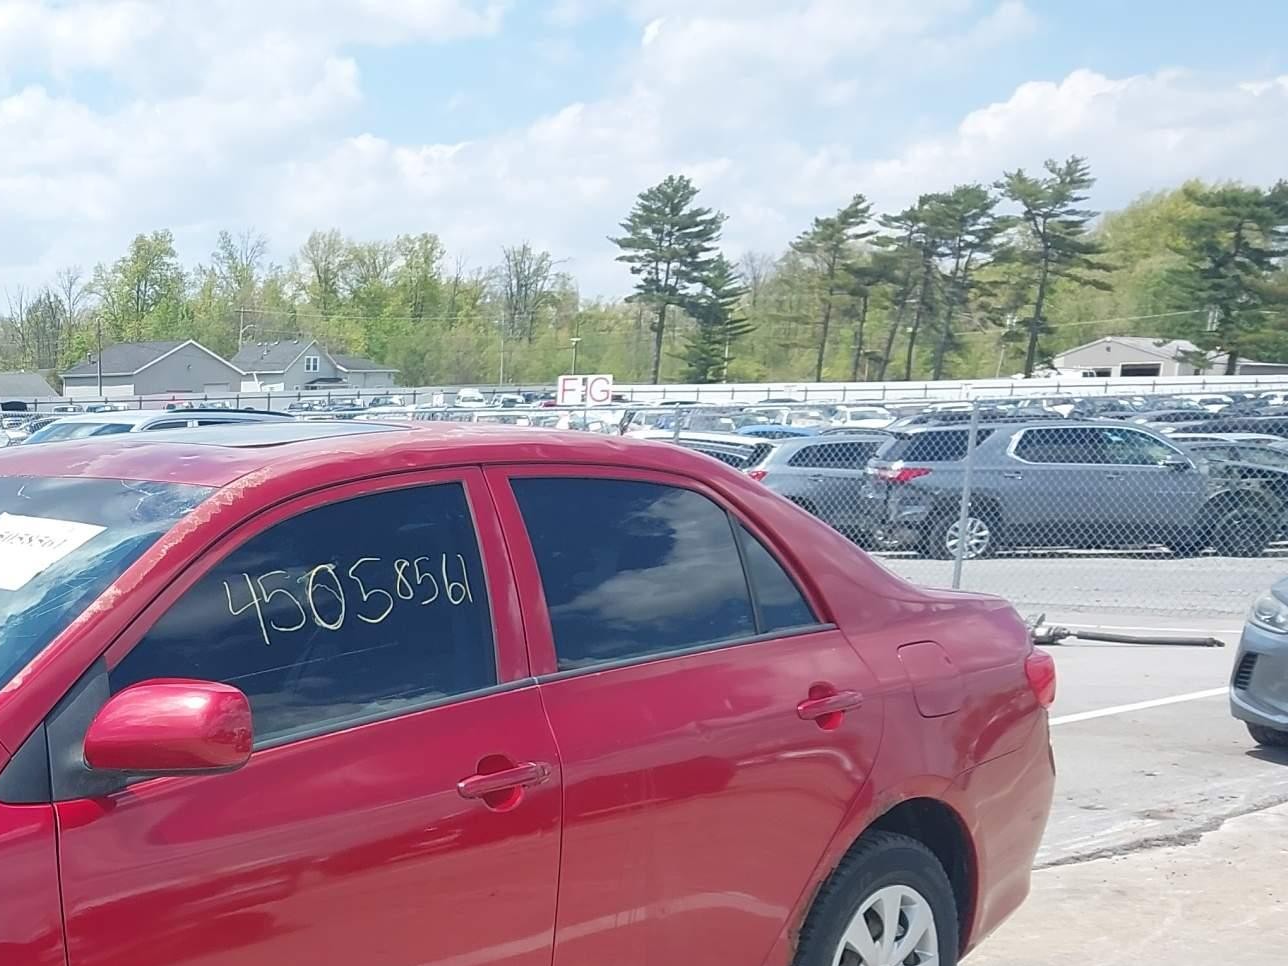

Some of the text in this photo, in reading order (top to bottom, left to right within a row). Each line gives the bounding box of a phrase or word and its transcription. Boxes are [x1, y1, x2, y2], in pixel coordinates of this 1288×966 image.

[560, 376, 610, 404] F G
[223, 552, 474, 645] 45058561
